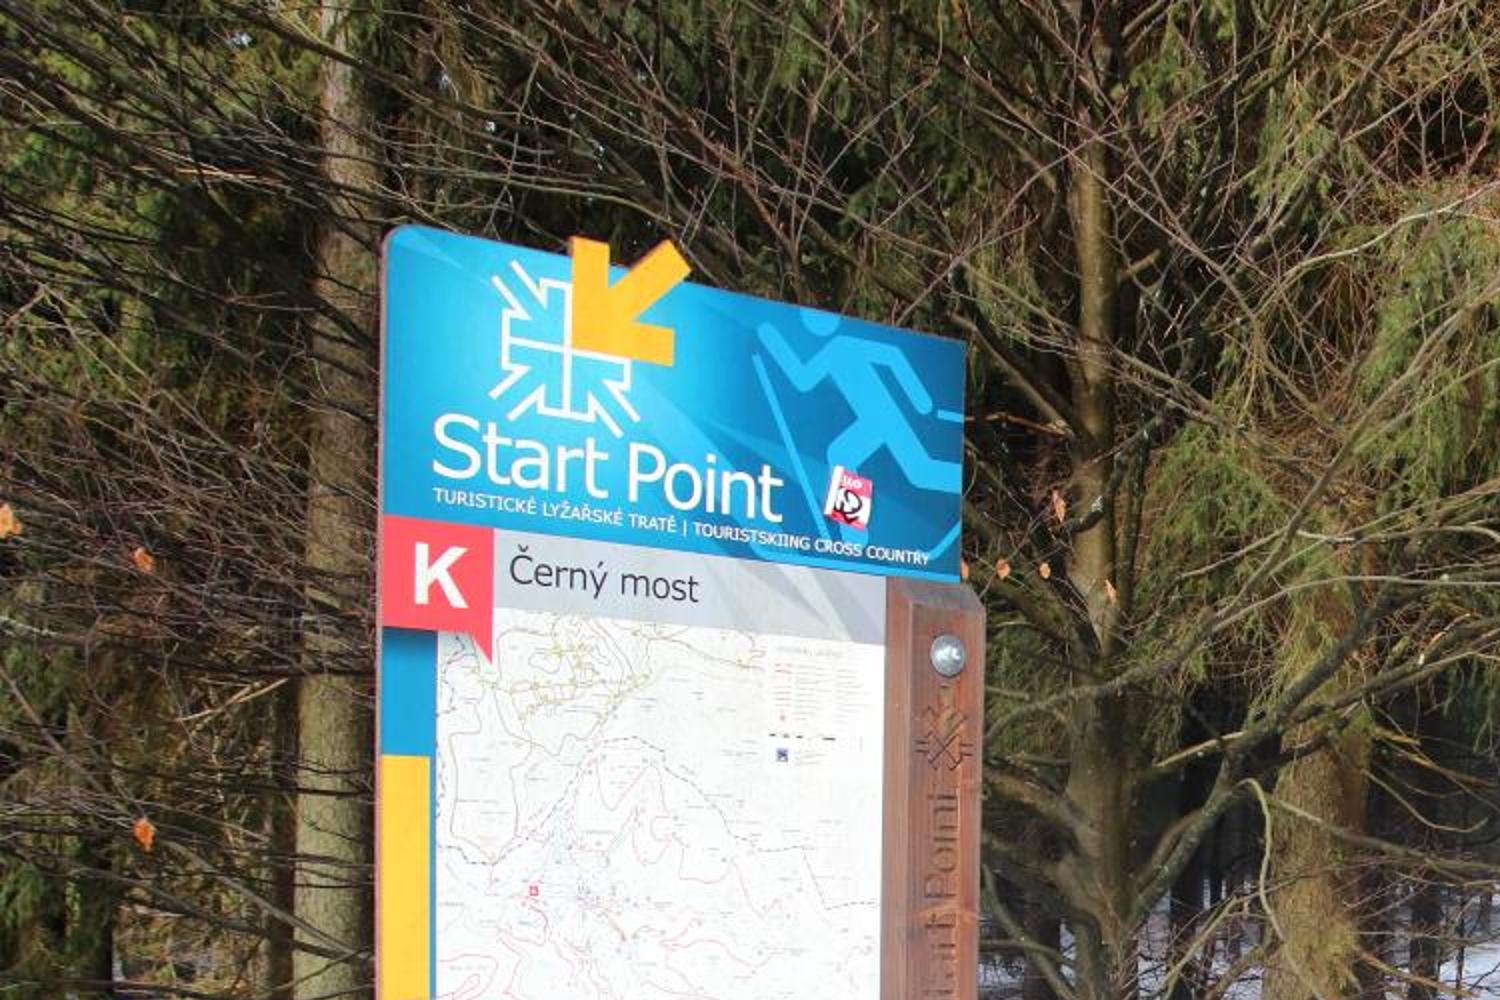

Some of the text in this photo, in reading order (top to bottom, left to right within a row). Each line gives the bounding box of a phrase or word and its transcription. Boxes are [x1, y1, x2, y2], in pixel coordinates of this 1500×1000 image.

[432, 413, 608, 499] Start
[628, 442, 784, 523] Point
[433, 487, 537, 515] TURISTICKÉ
[542, 500, 623, 526] LYŽAŘSKÉ
[693, 520, 811, 551] TOURISTSKIING
[814, 537, 863, 558] CROSS
[866, 545, 929, 566] COUNTRY
[414, 540, 469, 609] K
[509, 543, 700, 603] Černý most
